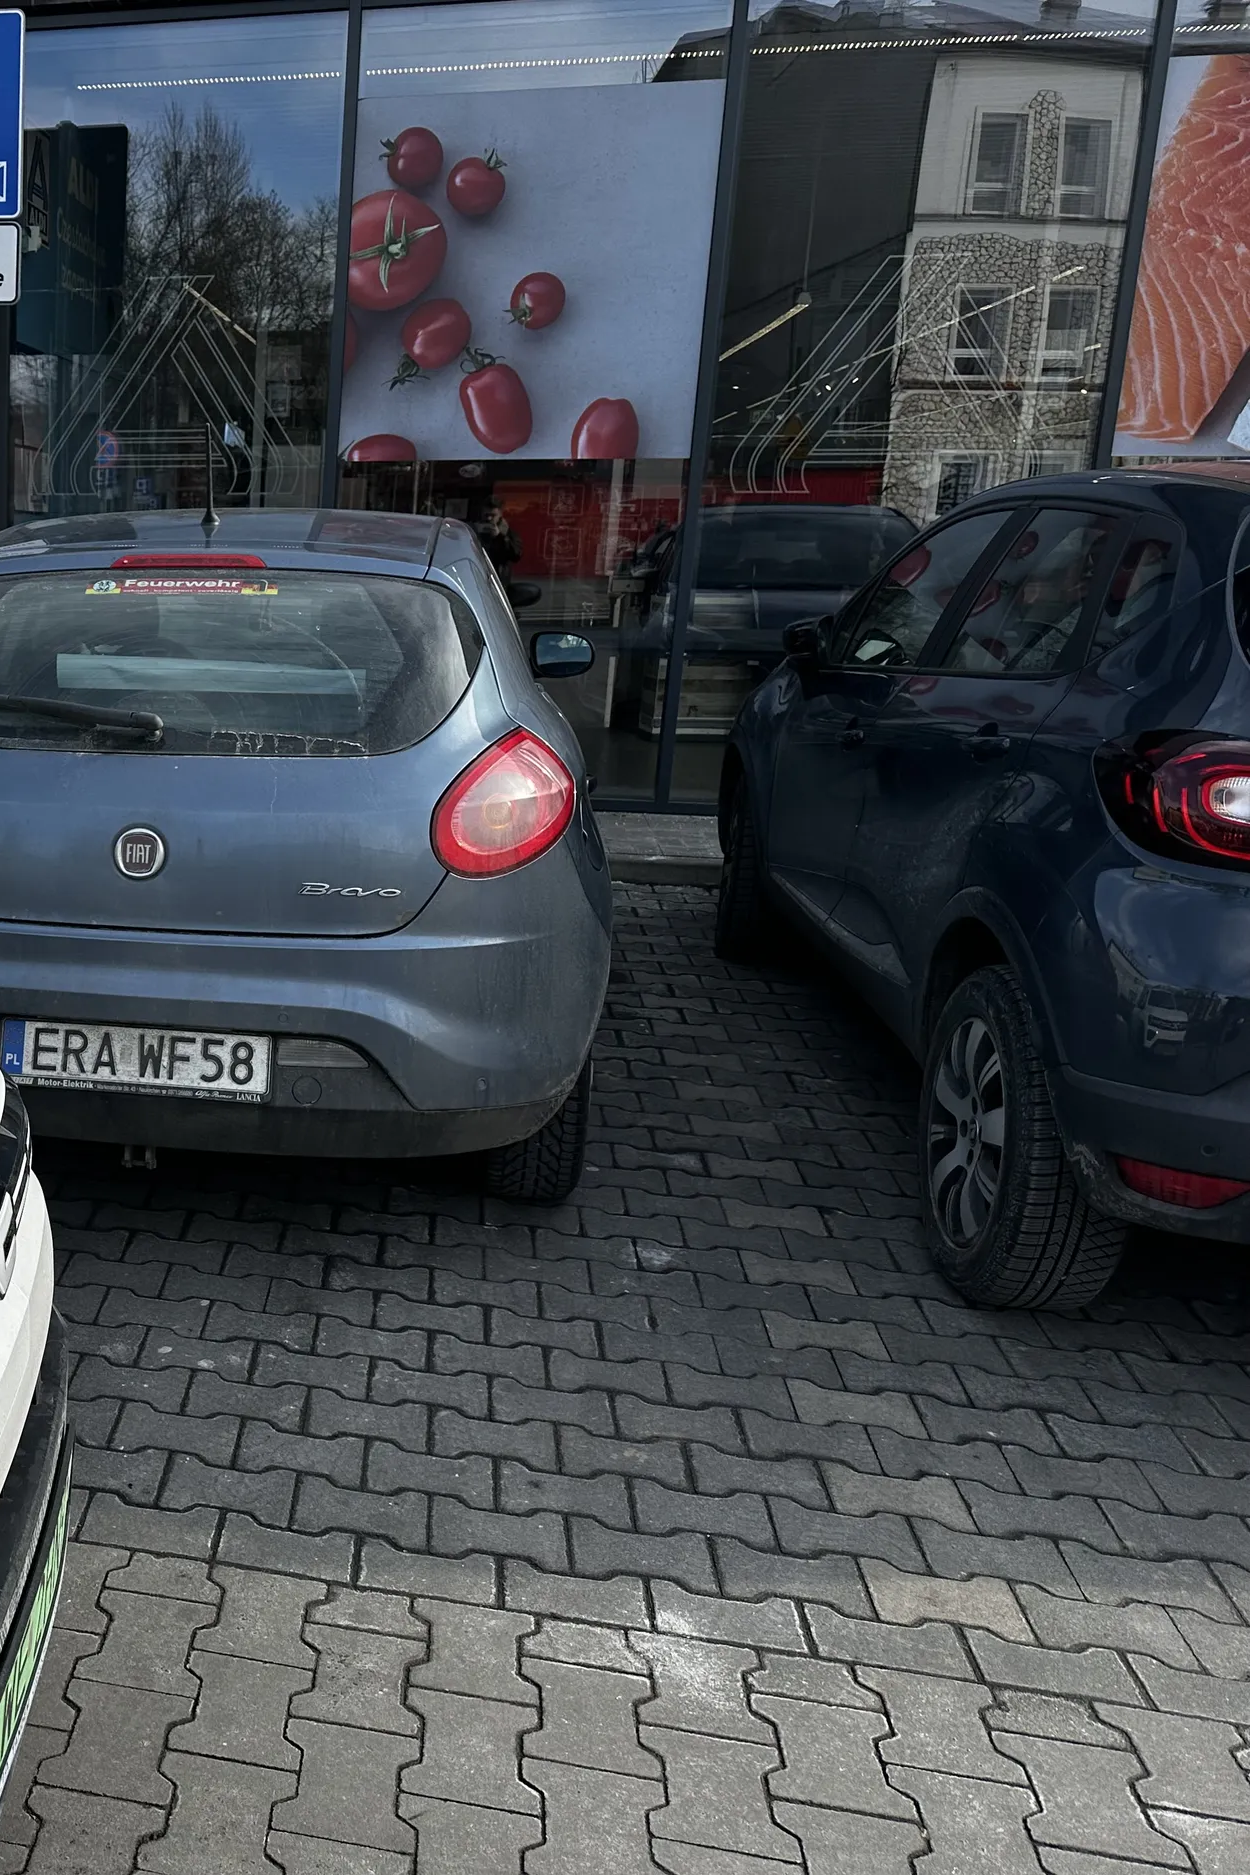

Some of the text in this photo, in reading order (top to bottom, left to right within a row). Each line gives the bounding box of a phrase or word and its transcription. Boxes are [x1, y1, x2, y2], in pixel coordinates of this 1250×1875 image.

[124, 579, 240, 587] Feuerwehr
[126, 843, 151, 864] FIAT
[298, 882, 401, 897] Bravo
[5, 1053, 20, 1066] PL
[32, 1027, 255, 1086] ERA WF58
[37, 1078, 94, 1089] Motor-Elektrik
[236, 1092, 261, 1102] LANCIA
